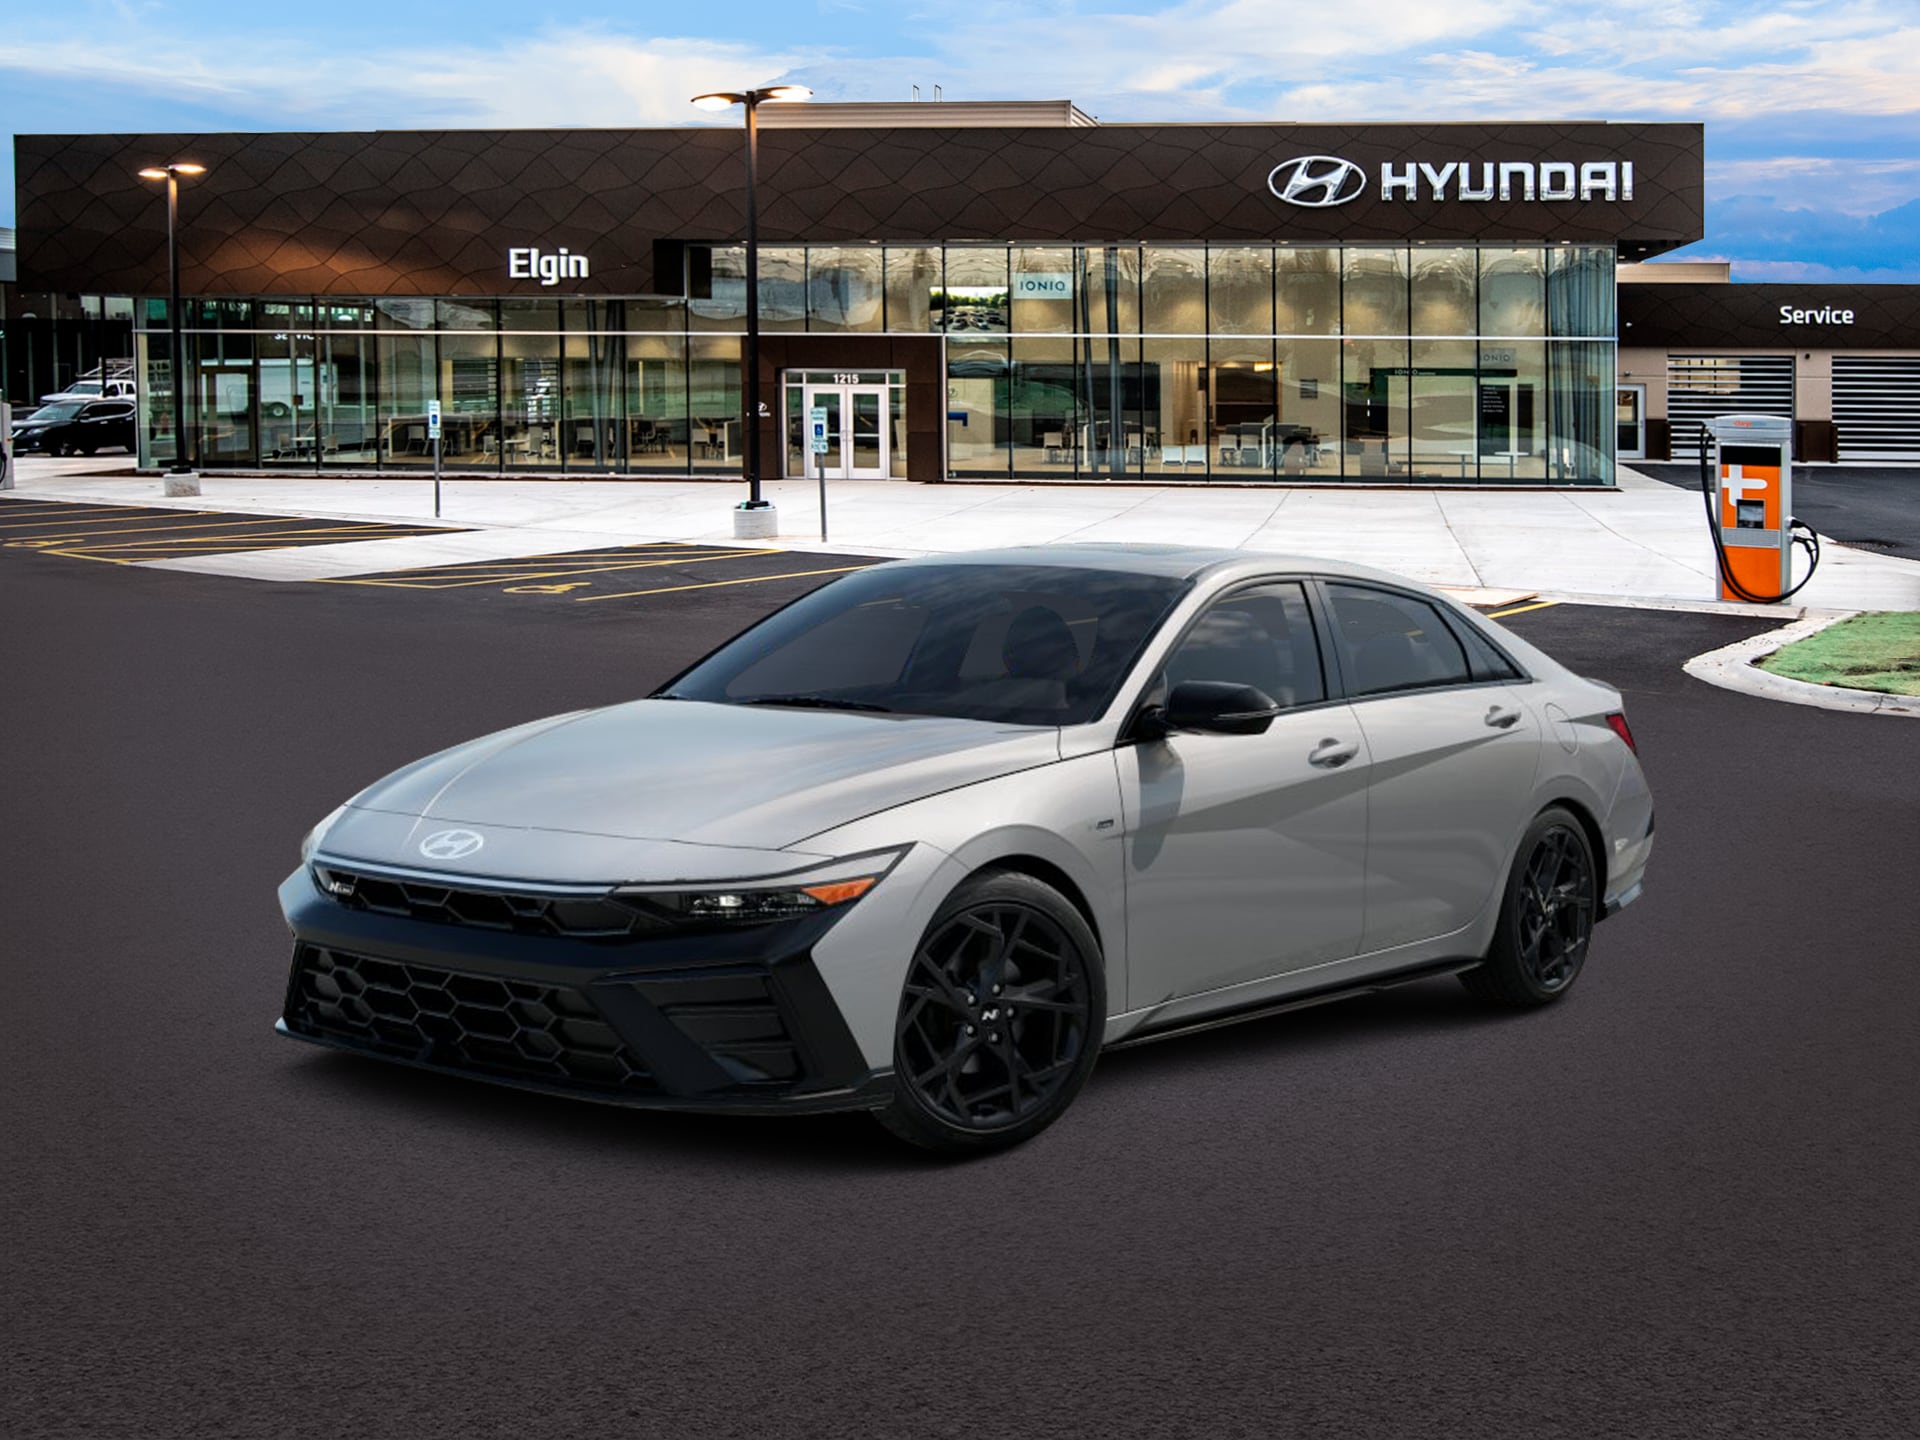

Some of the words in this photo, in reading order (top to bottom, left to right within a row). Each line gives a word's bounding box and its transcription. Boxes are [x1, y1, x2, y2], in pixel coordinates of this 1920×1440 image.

[1381, 162, 1633, 201] HYUNDAI
[509, 247, 589, 286] Elgin
[1020, 281, 1066, 291] IONIQ
[1779, 305, 1854, 324] Service
[833, 374, 859, 384] 1215
